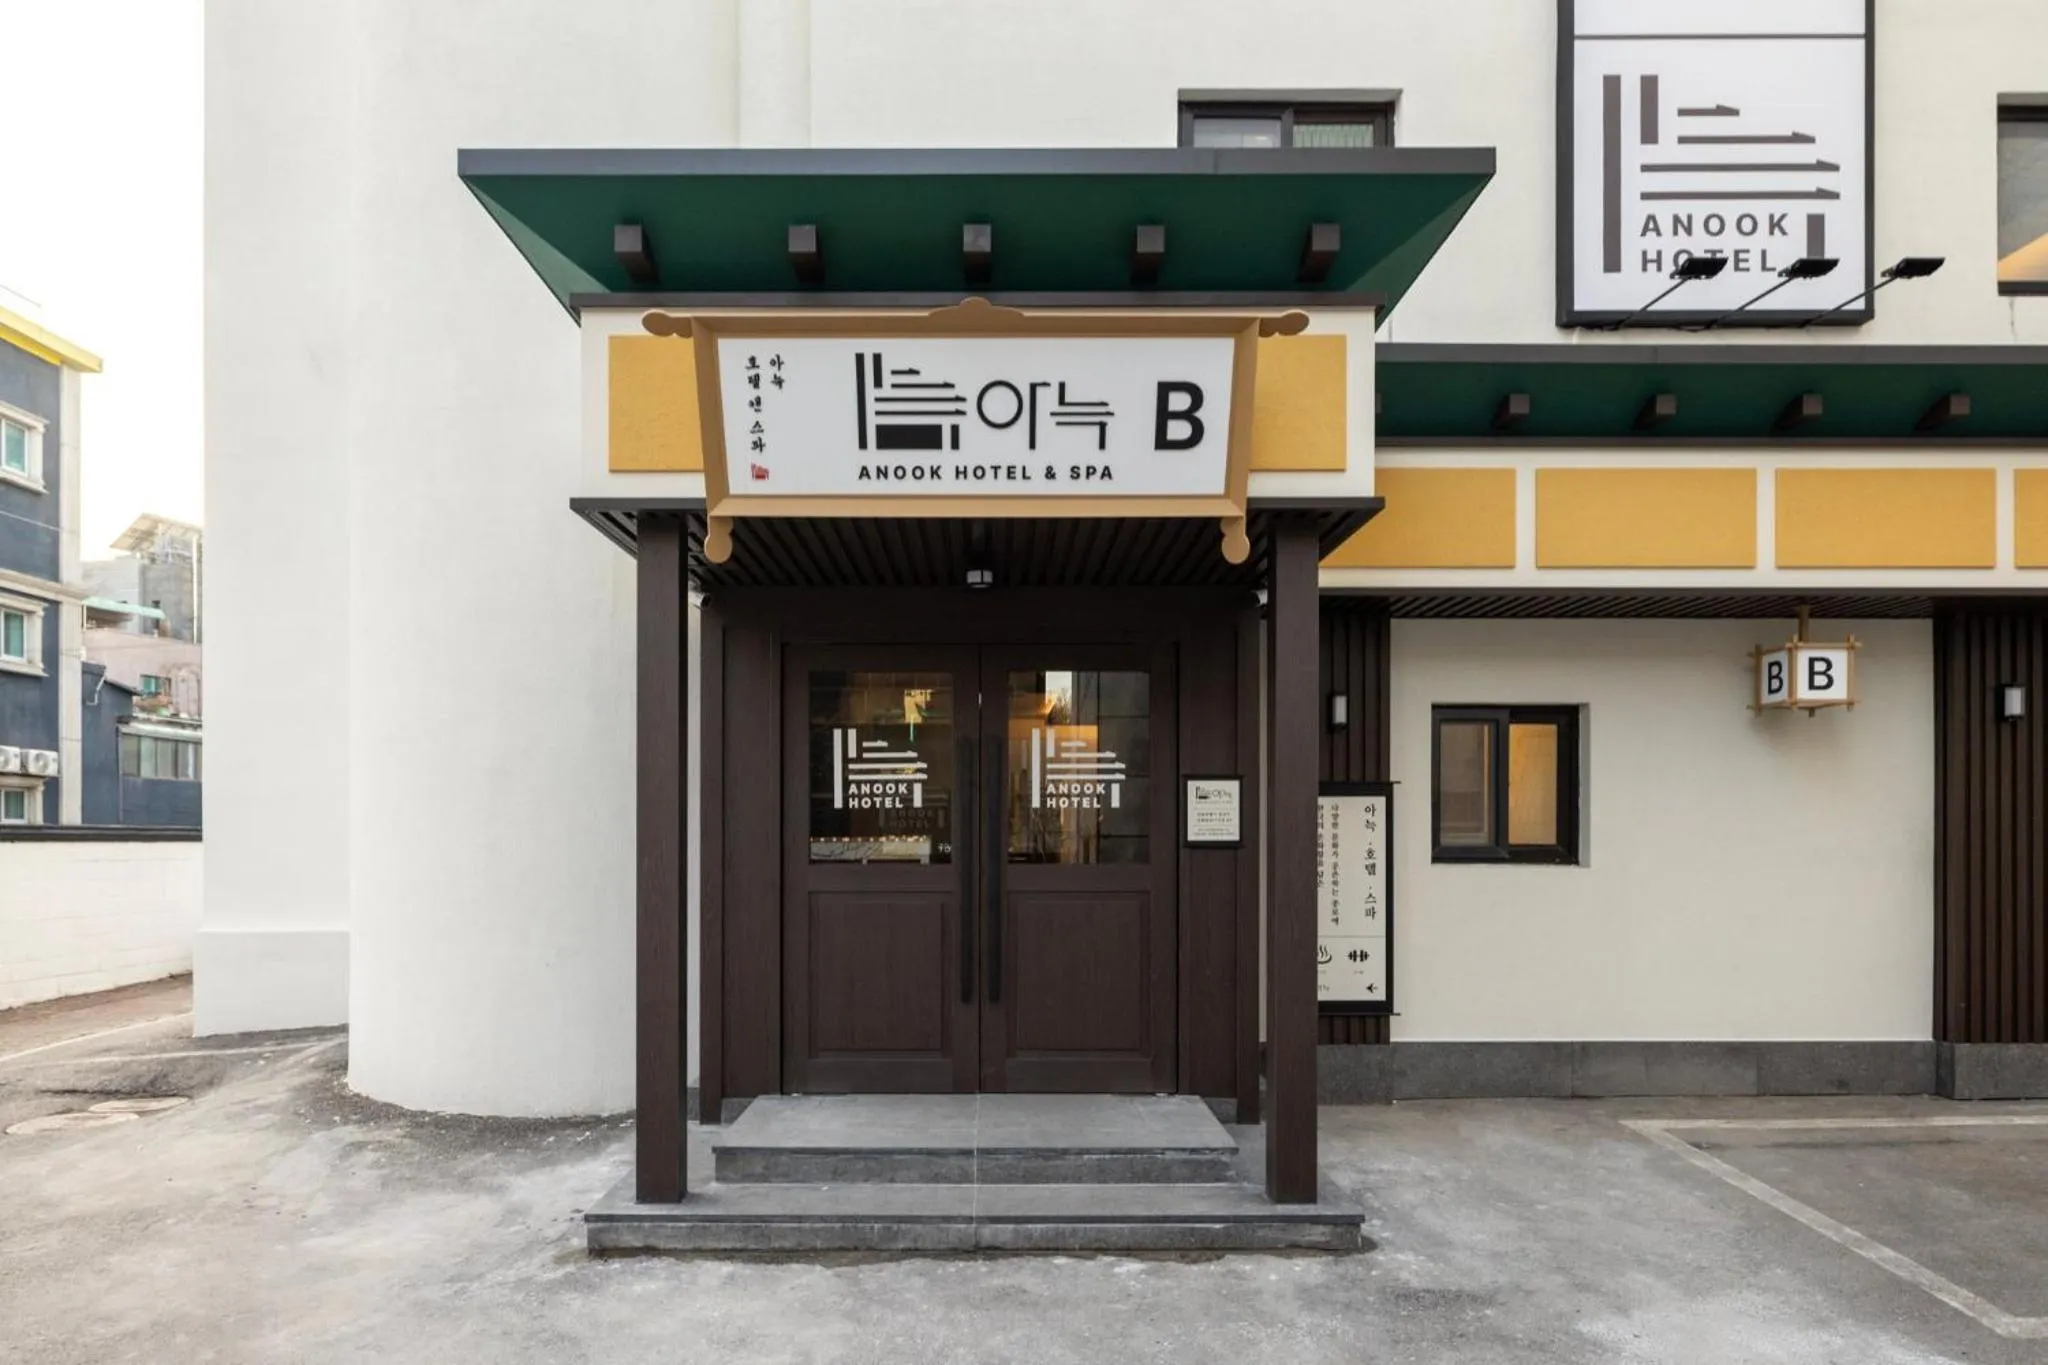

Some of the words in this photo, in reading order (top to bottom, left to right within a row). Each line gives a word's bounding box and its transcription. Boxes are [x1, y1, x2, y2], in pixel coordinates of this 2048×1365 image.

[1640, 213, 1789, 237] ANOOK
[1153, 381, 1205, 451] B
[858, 465, 942, 480] ANOOK
[955, 465, 1032, 480] HOTEL
[1044, 465, 1057, 480] &
[1069, 465, 1114, 480] SPA
[1767, 660, 1784, 695] B
[1808, 656, 1834, 691] B
[848, 783, 908, 795] ANOOK
[1046, 783, 1105, 795] ANOOK
[848, 797, 904, 809] HOTEL
[1046, 797, 1101, 809] HOTEL
